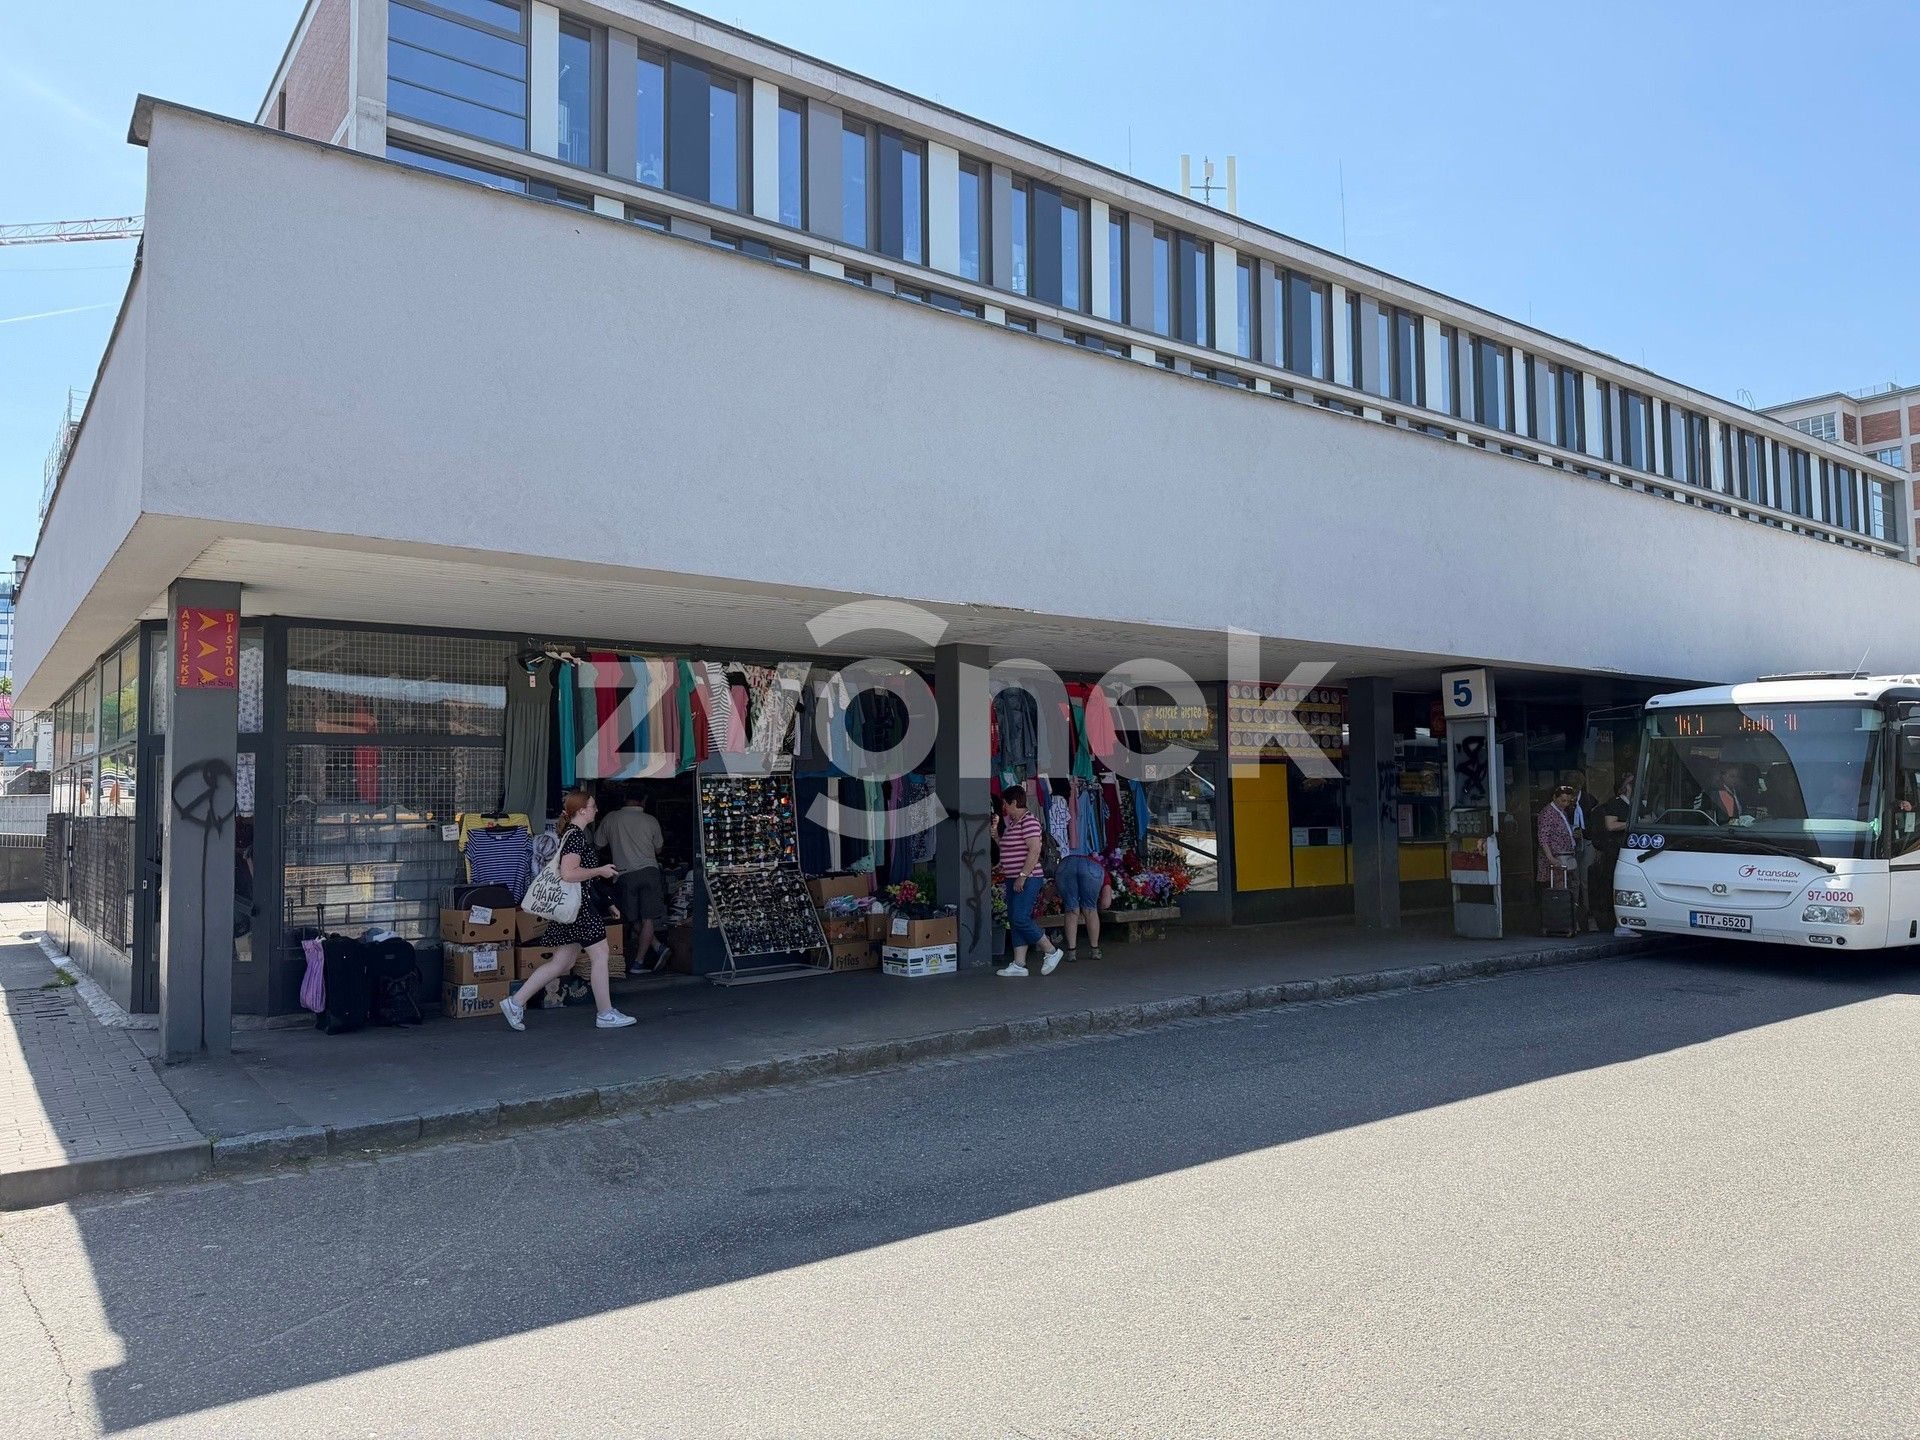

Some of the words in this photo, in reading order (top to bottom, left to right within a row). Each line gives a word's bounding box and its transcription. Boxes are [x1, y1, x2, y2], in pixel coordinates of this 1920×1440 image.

[224, 613, 234, 677] BISTRO
[1453, 679, 1472, 707] 5
[1757, 868, 1801, 878] transdev
[532, 883, 568, 905] CHANGE
[1807, 890, 1854, 903] 97-0020
[1698, 914, 1716, 926] 1TY
[1722, 916, 1746, 928] 6520
